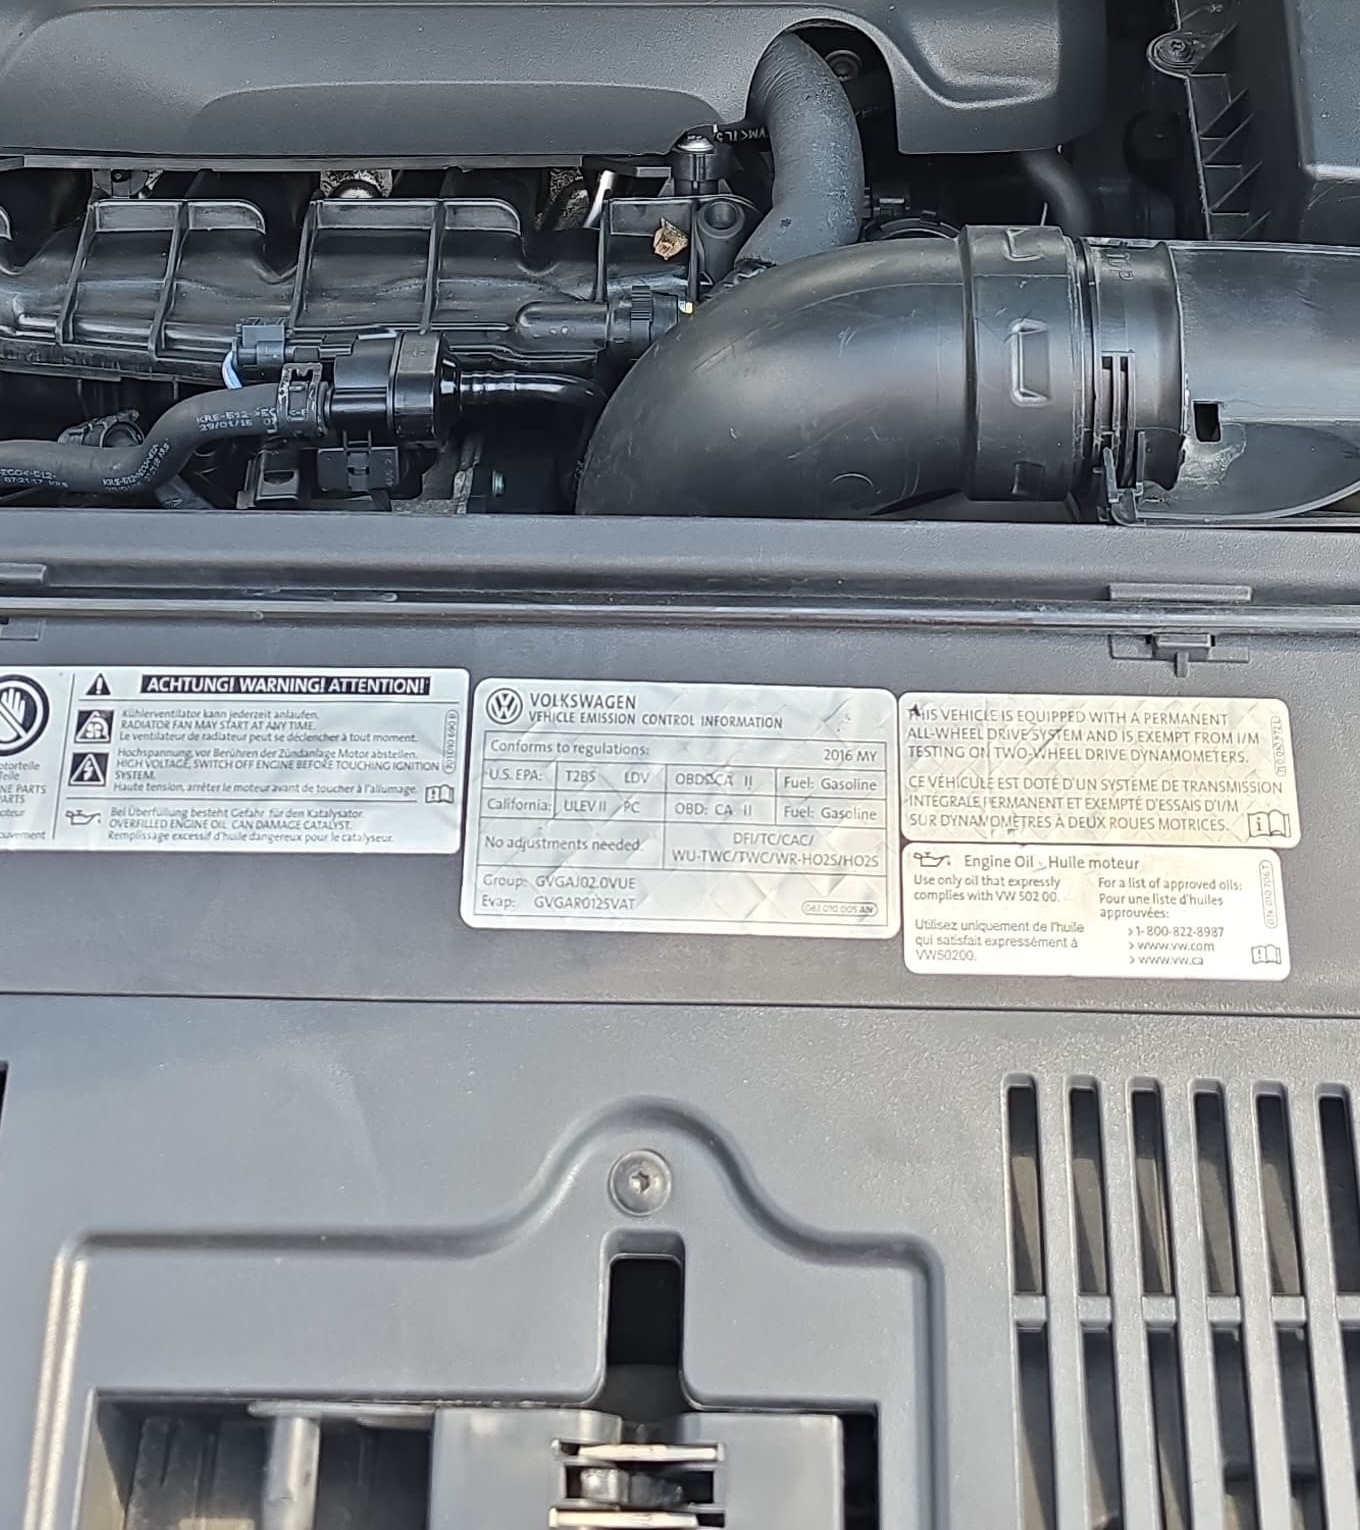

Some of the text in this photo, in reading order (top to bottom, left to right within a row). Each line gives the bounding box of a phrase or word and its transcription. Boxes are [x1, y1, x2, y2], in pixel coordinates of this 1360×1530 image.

[146, 678, 424, 693] ACHTUNG! WARNING! ATTENTION!
[530, 693, 636, 709] VOLKSWAGEN
[528, 711, 782, 729] VEHICLE EMISSION CONTROL INFORMATION
[940, 709, 999, 722] VEHICLE
[1001, 710, 1013, 722] IS
[1016, 711, 1085, 723] EQUIPPED
[1088, 712, 1126, 724] WITH
[1130, 712, 1139, 724] A
[1143, 713, 1227, 725] PERMANENT
[907, 728, 983, 740] ALL-WHEEL
[986, 729, 1029, 741] DRIVE
[1086, 730, 1117, 742] AND
[1121, 731, 1133, 742] IS
[1134, 731, 1190, 743] EXEMPT
[1194, 732, 1232, 744] FROM
[1236, 732, 1259, 744] I/M
[490, 739, 649, 758] Conforms to regulations:
[823, 749, 877, 762] 2016 MY
[908, 746, 965, 758] TESTING
[968, 747, 990, 759] ON
[1084, 749, 1127, 761] DRIVE
[1130, 749, 1248, 763] DYNAMOMETERS.
[490, 769, 513, 781] U.S.
[566, 770, 595, 782] T2B5
[624, 772, 650, 783] LDV
[784, 776, 877, 790] Fuel: Gasoline
[908, 776, 924, 787] CE
[997, 777, 1018, 789] EST
[1062, 778, 1097, 790] D'UN
[1161, 780, 1178, 792] DE
[1183, 780, 1282, 793] TRANSMISSION
[488, 798, 640, 813] California: ULEV II PC
[1066, 798, 1080, 809] ET
[1084, 795, 1141, 810] EXEMPTÉ
[1145, 799, 1201, 811] D'ESSAIS
[1203, 800, 1238, 812] D'I/M
[784, 806, 877, 820] Fuel: Gasoline
[910, 814, 937, 826] SUR
[1067, 817, 1105, 829] DEUX
[1109, 817, 1154, 830] ROUES
[1158, 818, 1229, 831] MOTRICES.
[485, 836, 504, 848] No
[506, 836, 588, 853] adjustments
[964, 855, 1140, 870] Engine Oil Huile moteur
[914, 874, 1060, 889] Use only oil that expressly
[1098, 878, 1115, 888] For
[1118, 880, 1125, 889] a
[1128, 878, 1145, 889] list
[1148, 878, 1159, 889] of
[1163, 878, 1216, 893] approved
[914, 890, 964, 903] complies
[966, 890, 993, 901] with
[995, 891, 1015, 901] VW
[1018, 891, 1039, 902] 502
[1099, 893, 1124, 904] Pour
[1127, 896, 1149, 905] une
[1152, 894, 1176, 905] liste
